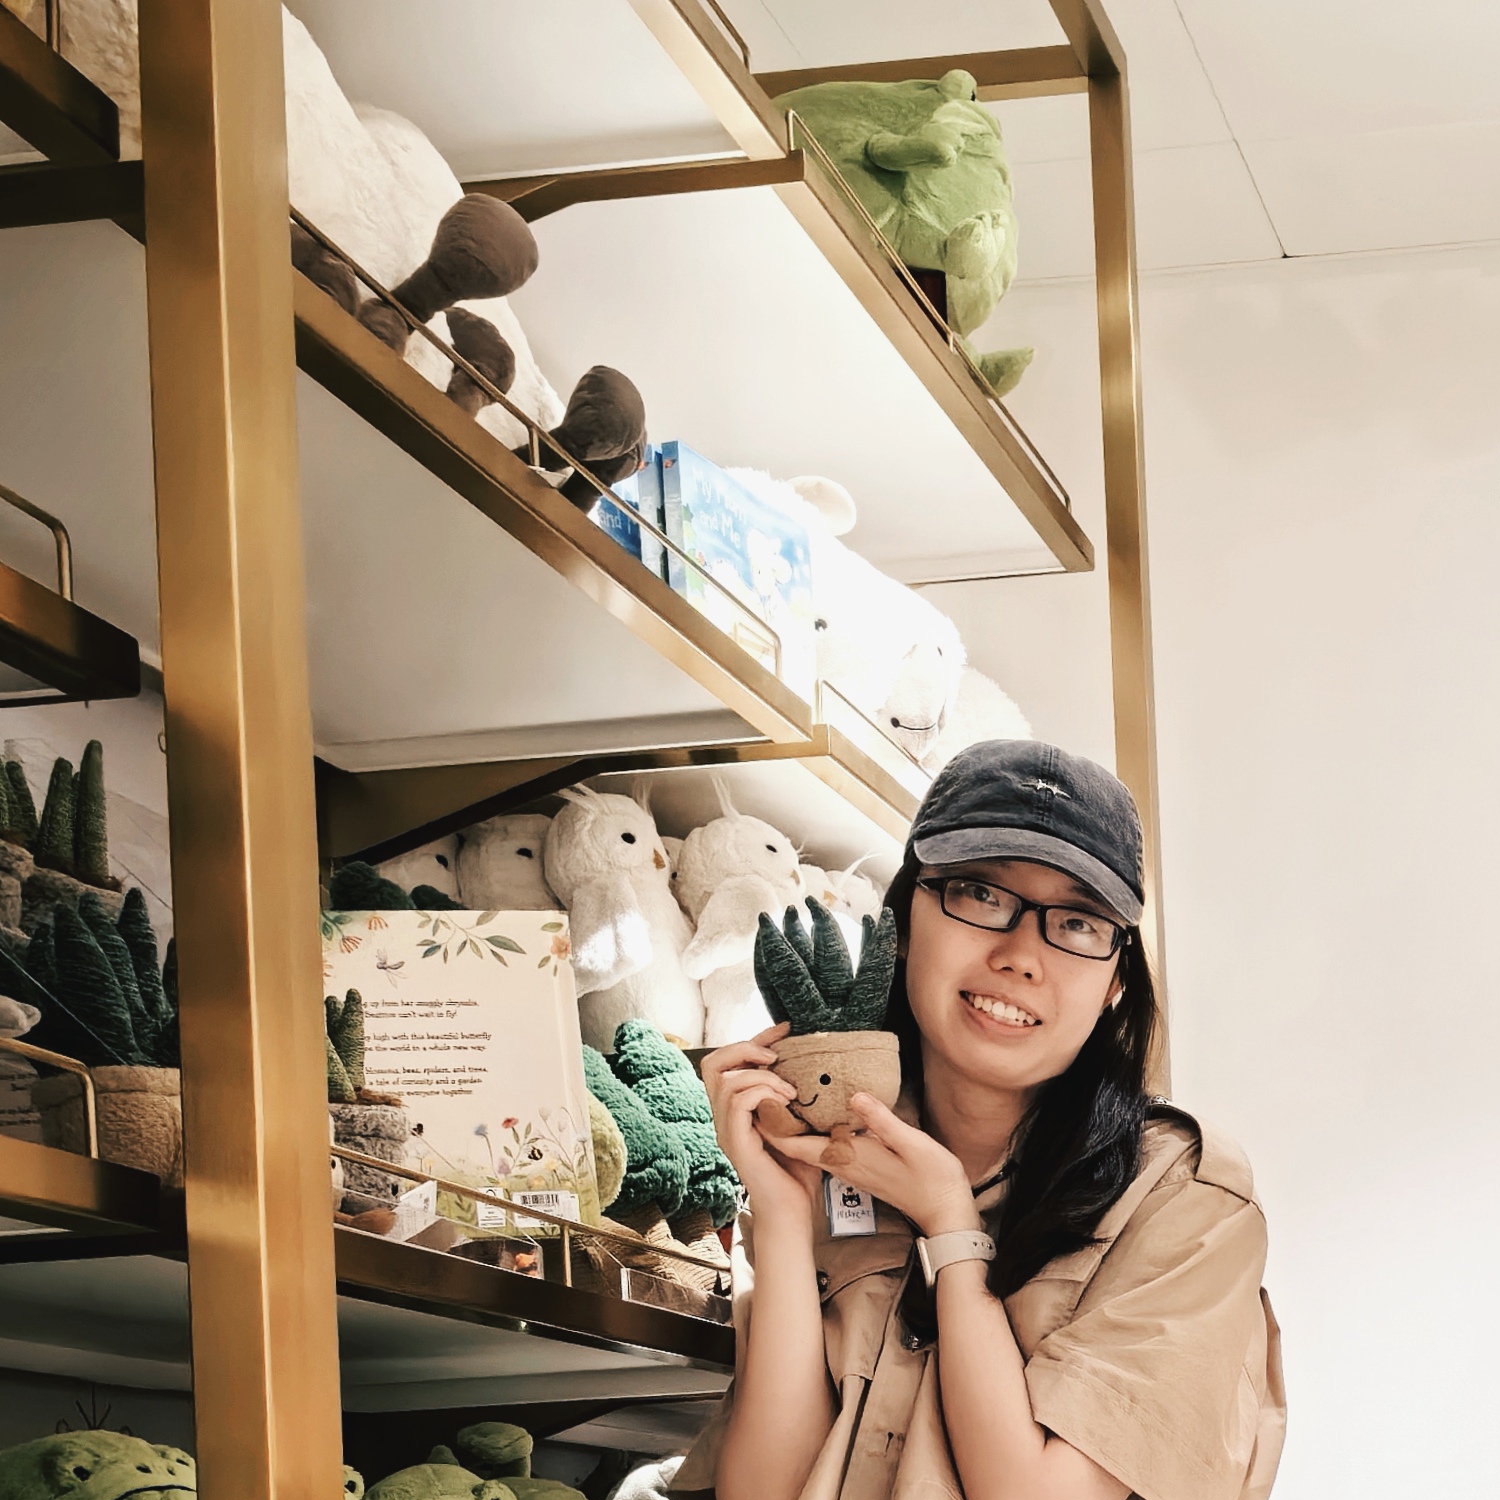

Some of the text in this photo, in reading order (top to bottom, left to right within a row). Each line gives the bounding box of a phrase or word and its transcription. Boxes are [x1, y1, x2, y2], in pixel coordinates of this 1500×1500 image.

[699, 510, 742, 550] and Me
[382, 998, 399, 1007] from
[418, 1010, 434, 1018] wait
[373, 1032, 390, 1042] high
[391, 1032, 409, 1040] with
[410, 1032, 424, 1040] this
[426, 1031, 459, 1040] beautiful
[375, 1043, 388, 1051] the
[390, 1043, 411, 1052] world
[428, 1043, 451, 1051] whole
[452, 1065, 466, 1073] and
[375, 1078, 389, 1086] tale
[391, 1077, 400, 1085] of
[435, 1076, 449, 1085] and
[406, 1090, 440, 1098] everyone
